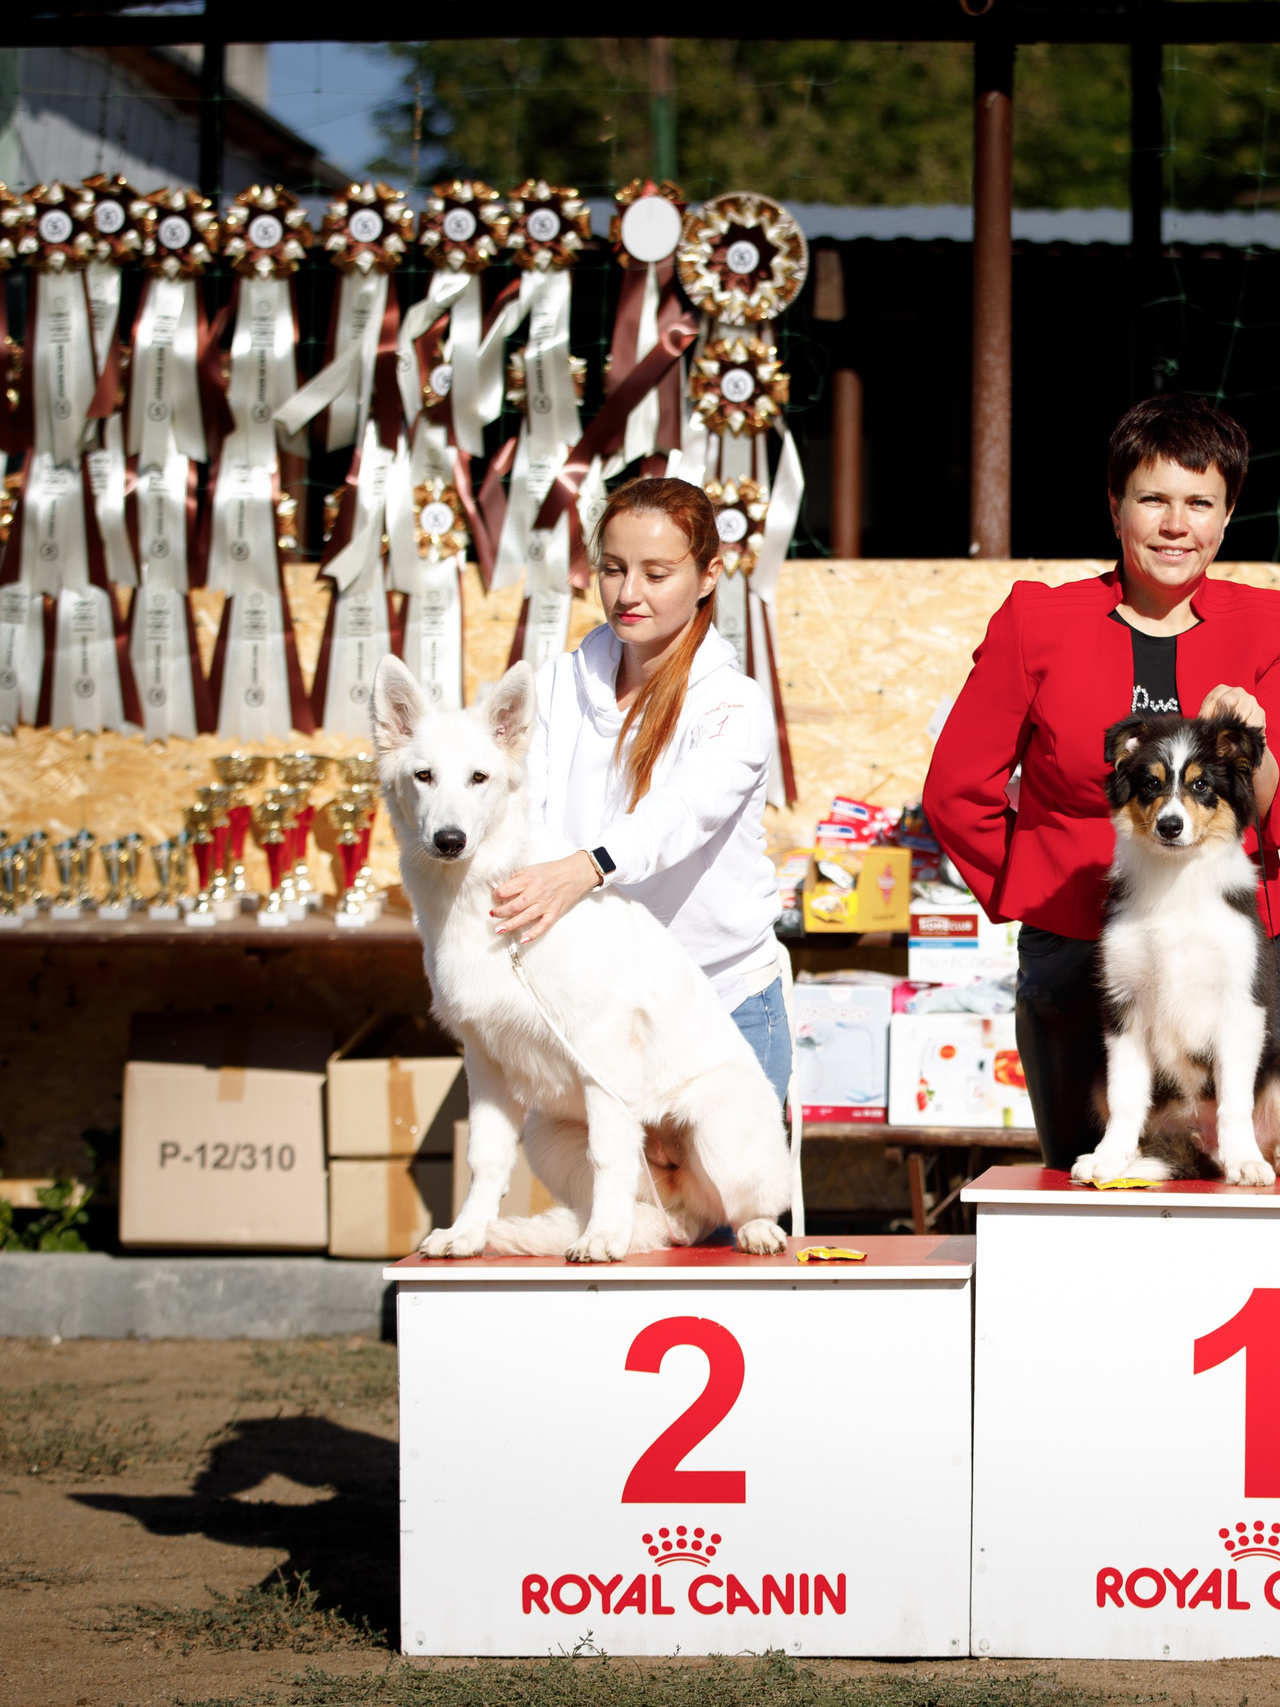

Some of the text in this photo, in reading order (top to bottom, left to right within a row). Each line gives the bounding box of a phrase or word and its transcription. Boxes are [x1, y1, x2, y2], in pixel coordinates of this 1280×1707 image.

[159, 1141, 296, 1171] P-12/310
[621, 1316, 746, 1503] 2
[522, 1573, 846, 1616] ROYAL CANIN
[1096, 1567, 1250, 1610] ROYAL
